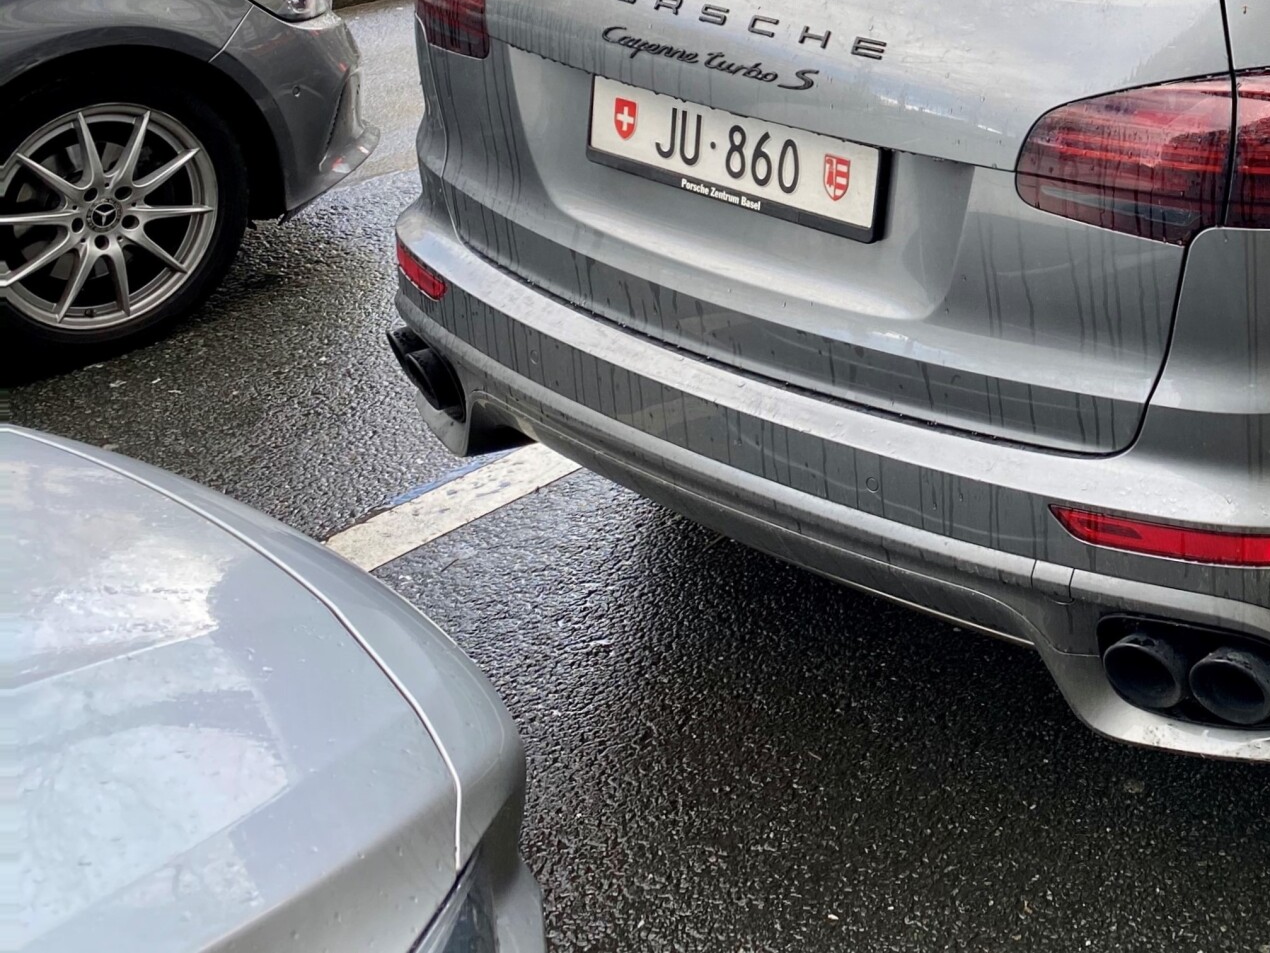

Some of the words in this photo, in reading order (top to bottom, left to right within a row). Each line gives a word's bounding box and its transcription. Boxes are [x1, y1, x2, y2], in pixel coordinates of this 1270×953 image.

[601, 25, 700, 65] Cayenne
[703, 51, 779, 84] turbo
[777, 68, 819, 91] S
[681, 178, 710, 196] Porsche
[710, 187, 740, 205] Zentrum
[741, 196, 761, 211] Basel
